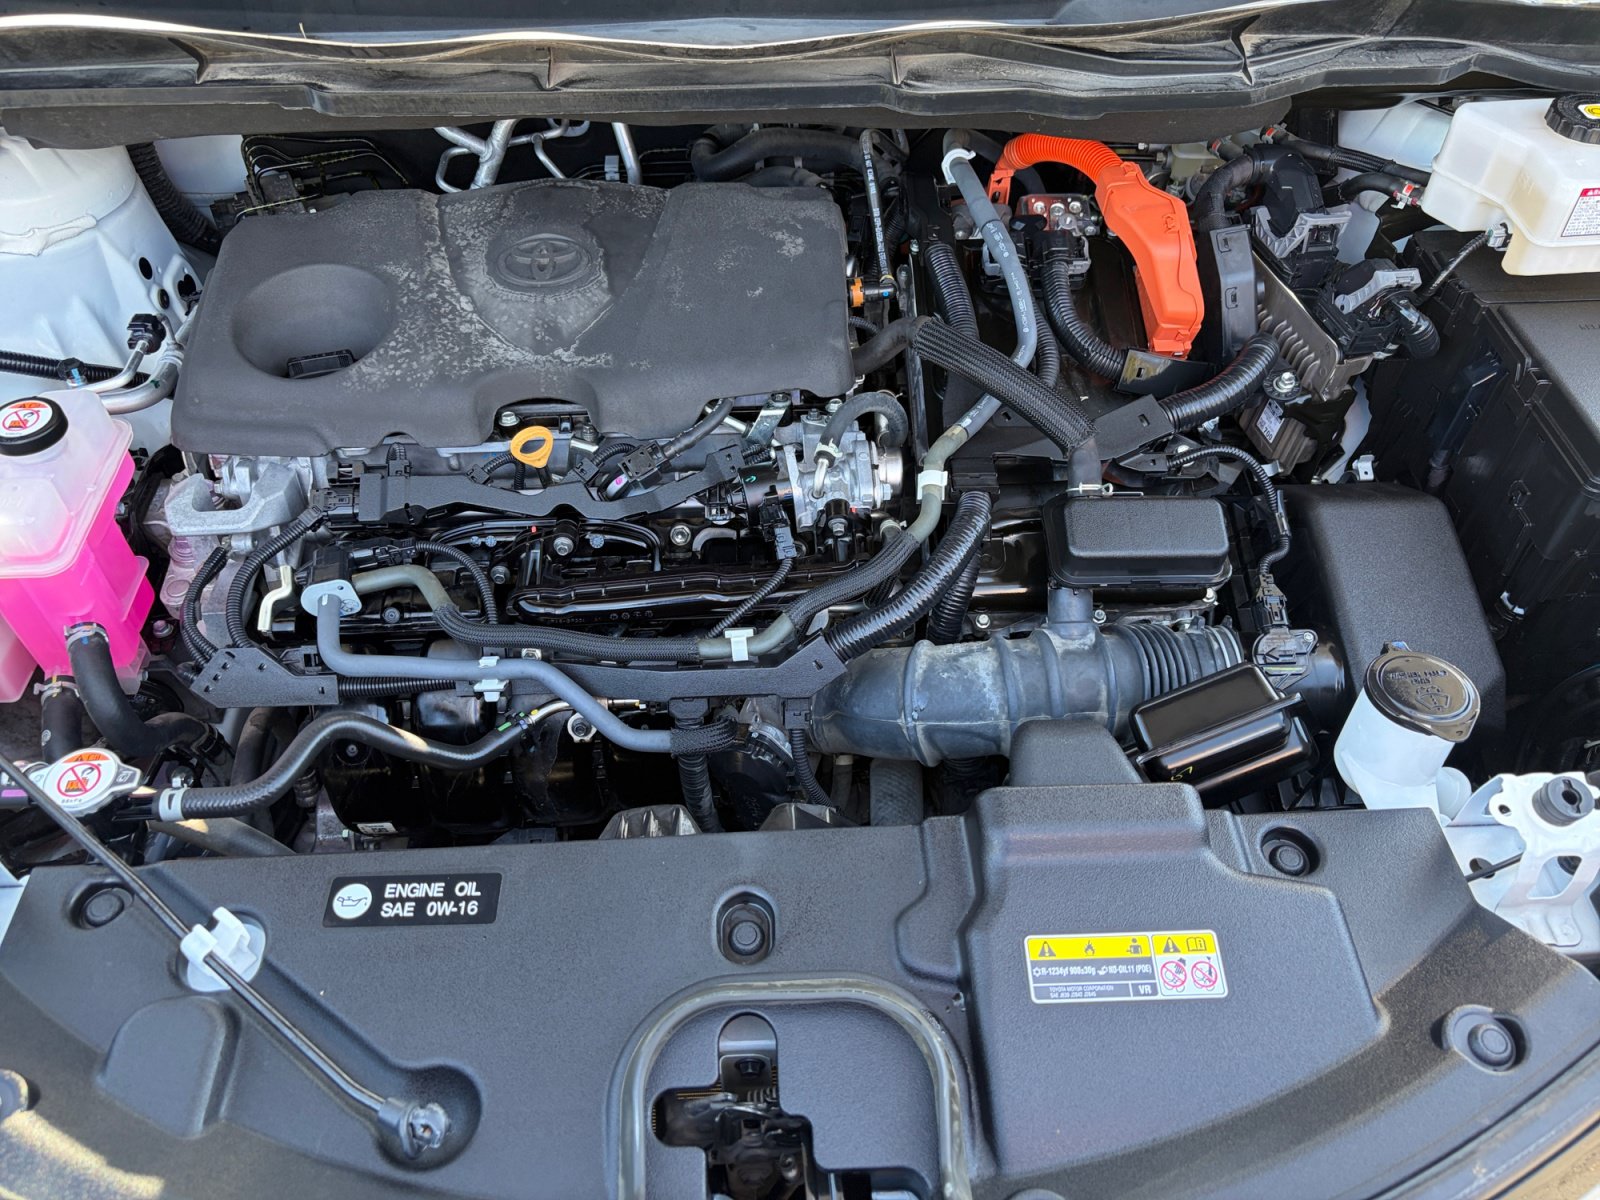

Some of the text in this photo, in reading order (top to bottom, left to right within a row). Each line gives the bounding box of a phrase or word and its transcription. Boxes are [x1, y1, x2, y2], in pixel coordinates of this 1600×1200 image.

[384, 881, 481, 898] ENGINE OIL
[380, 901, 478, 918] SAE 0W-16
[1136, 963, 1152, 974] (POE)
[1138, 984, 1152, 994] VR
